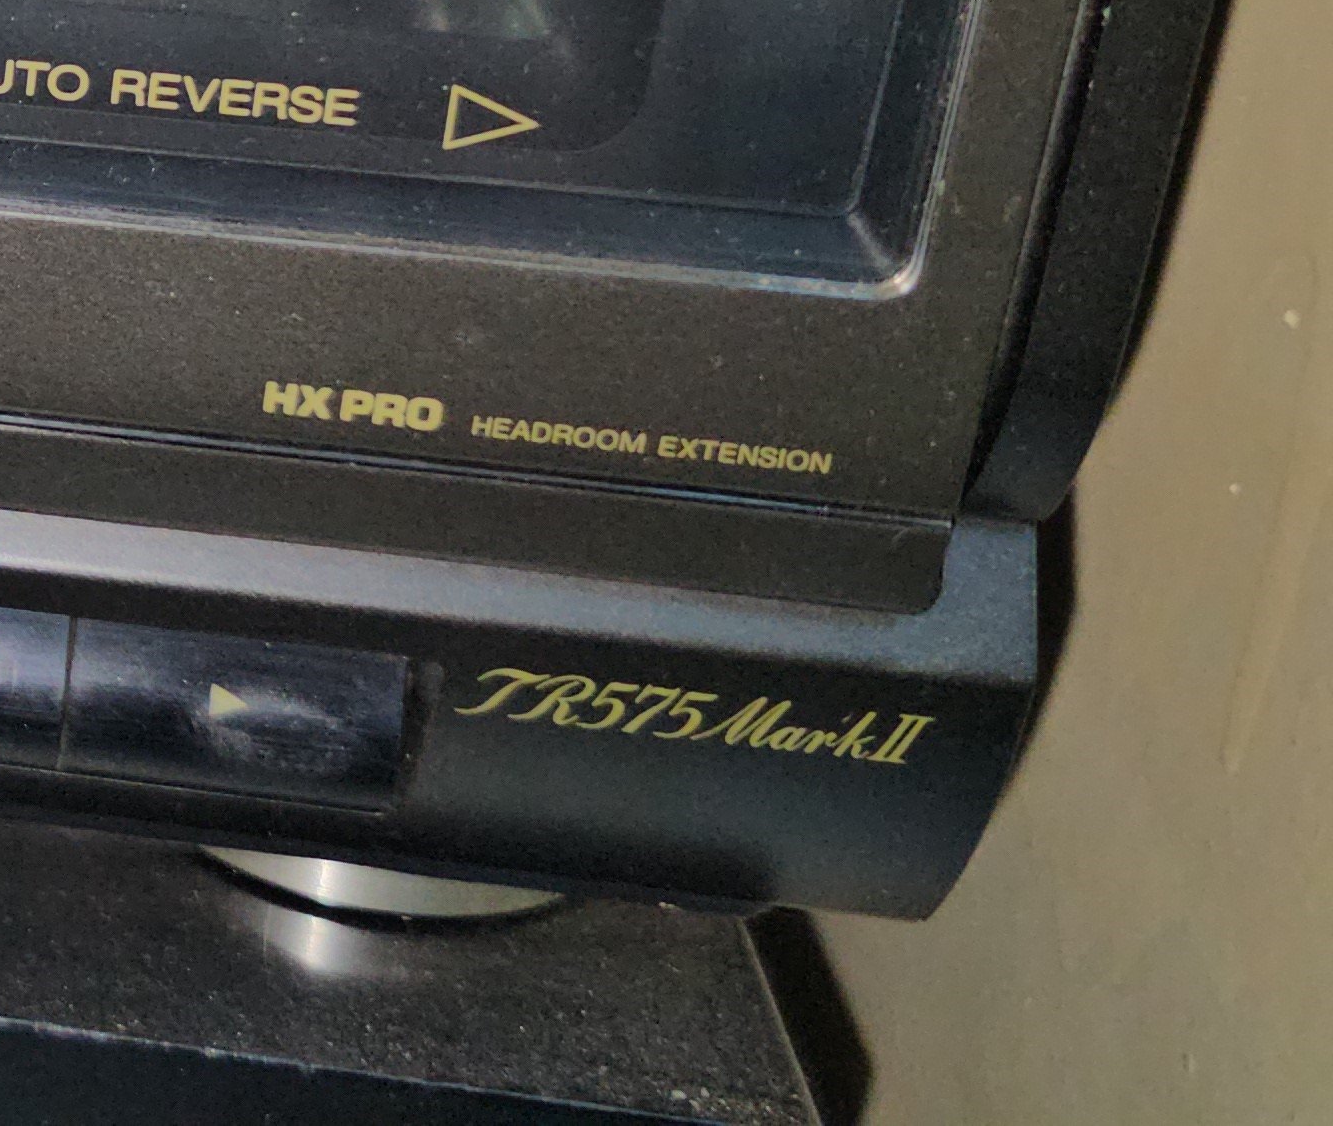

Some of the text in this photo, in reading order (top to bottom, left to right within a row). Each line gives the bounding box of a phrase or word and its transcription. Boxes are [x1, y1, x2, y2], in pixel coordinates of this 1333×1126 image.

[110, 68, 361, 127] REVERSE
[262, 380, 443, 432] HX PRO
[470, 415, 833, 475] HEADROOM EXTENSION
